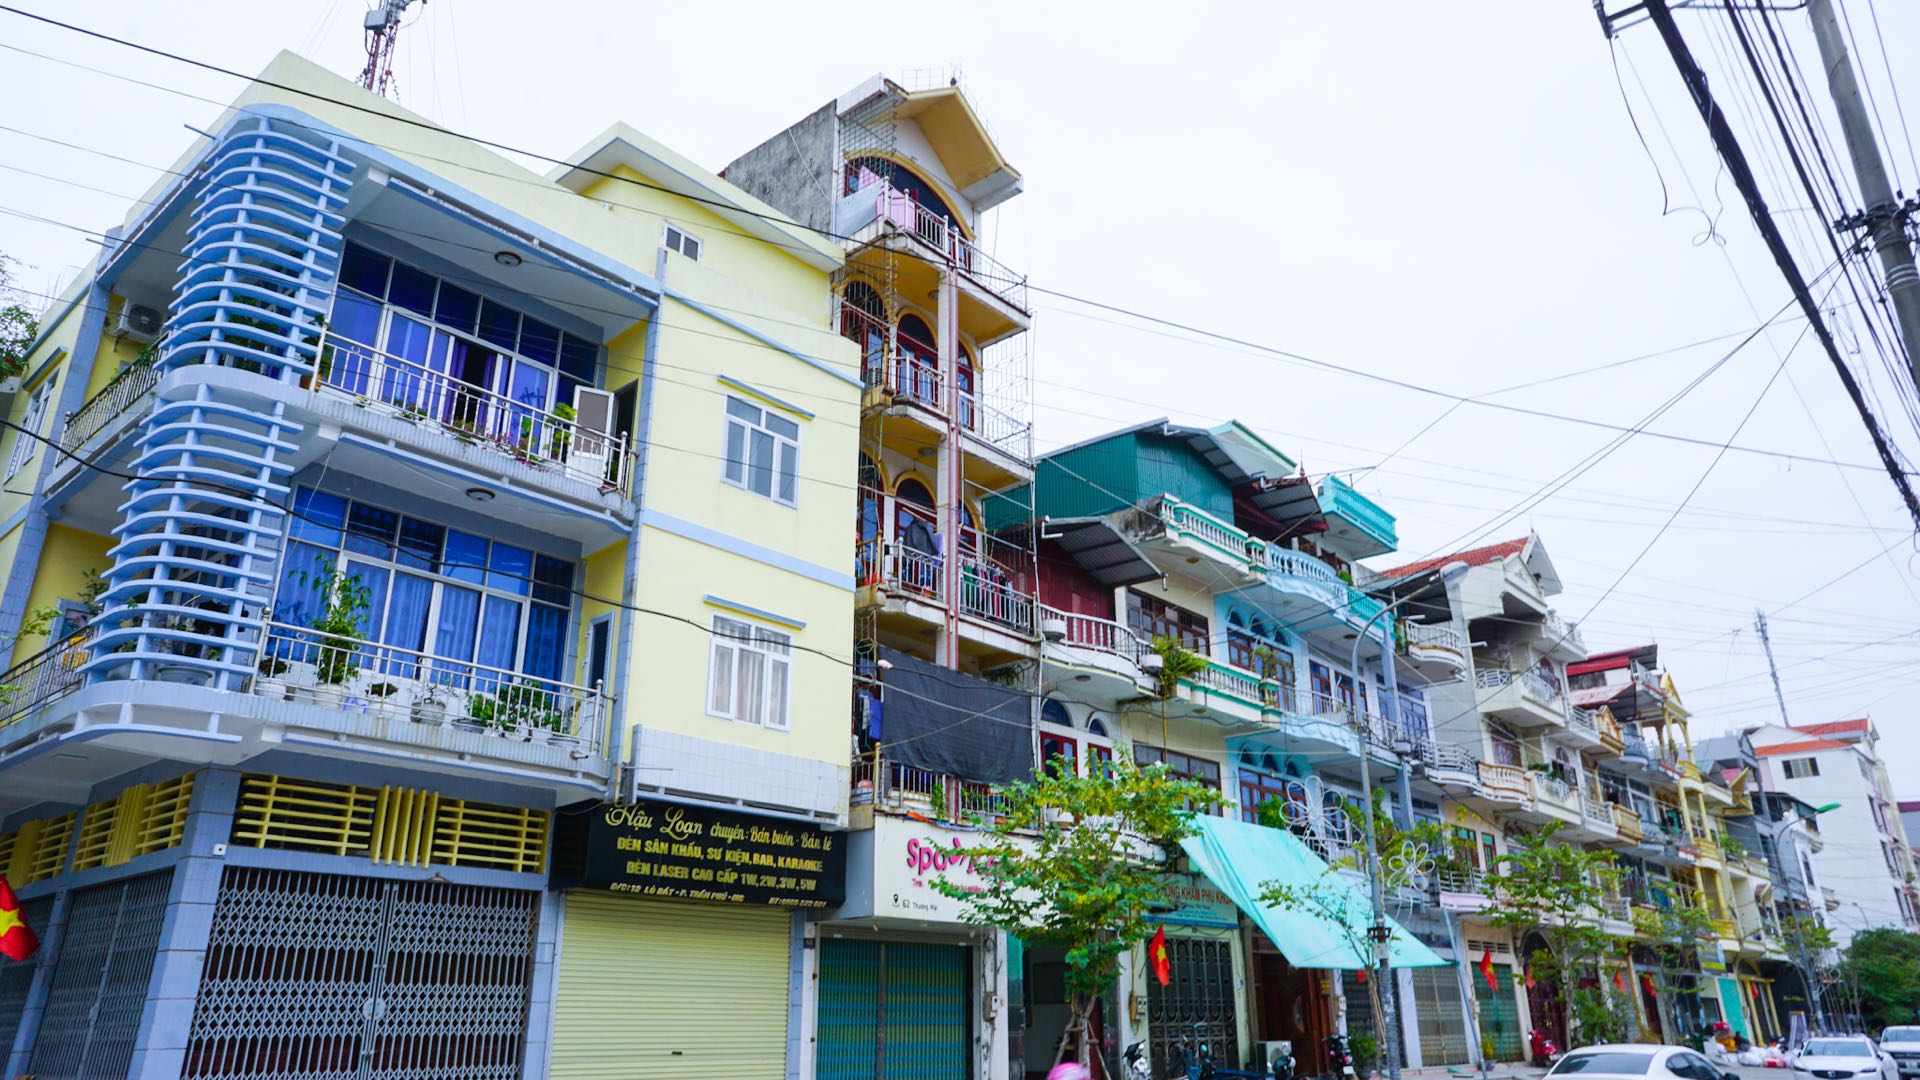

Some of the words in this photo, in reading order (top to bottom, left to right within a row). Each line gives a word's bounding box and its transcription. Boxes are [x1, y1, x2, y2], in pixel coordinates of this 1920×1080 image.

[605, 802, 653, 831] Hậu
[660, 806, 703, 840] Loan
[750, 826, 771, 843] Bán
[771, 829, 795, 847] buôn
[801, 832, 821, 850] Bán
[617, 835, 642, 852] ĐÈN
[671, 841, 704, 860] KHẤU,
[778, 856, 823, 872] KARAOKE
[626, 859, 651, 876] ĐÈN
[653, 863, 689, 879] LASER
[691, 868, 714, 882] CAO
[716, 867, 738, 884] CẤP
